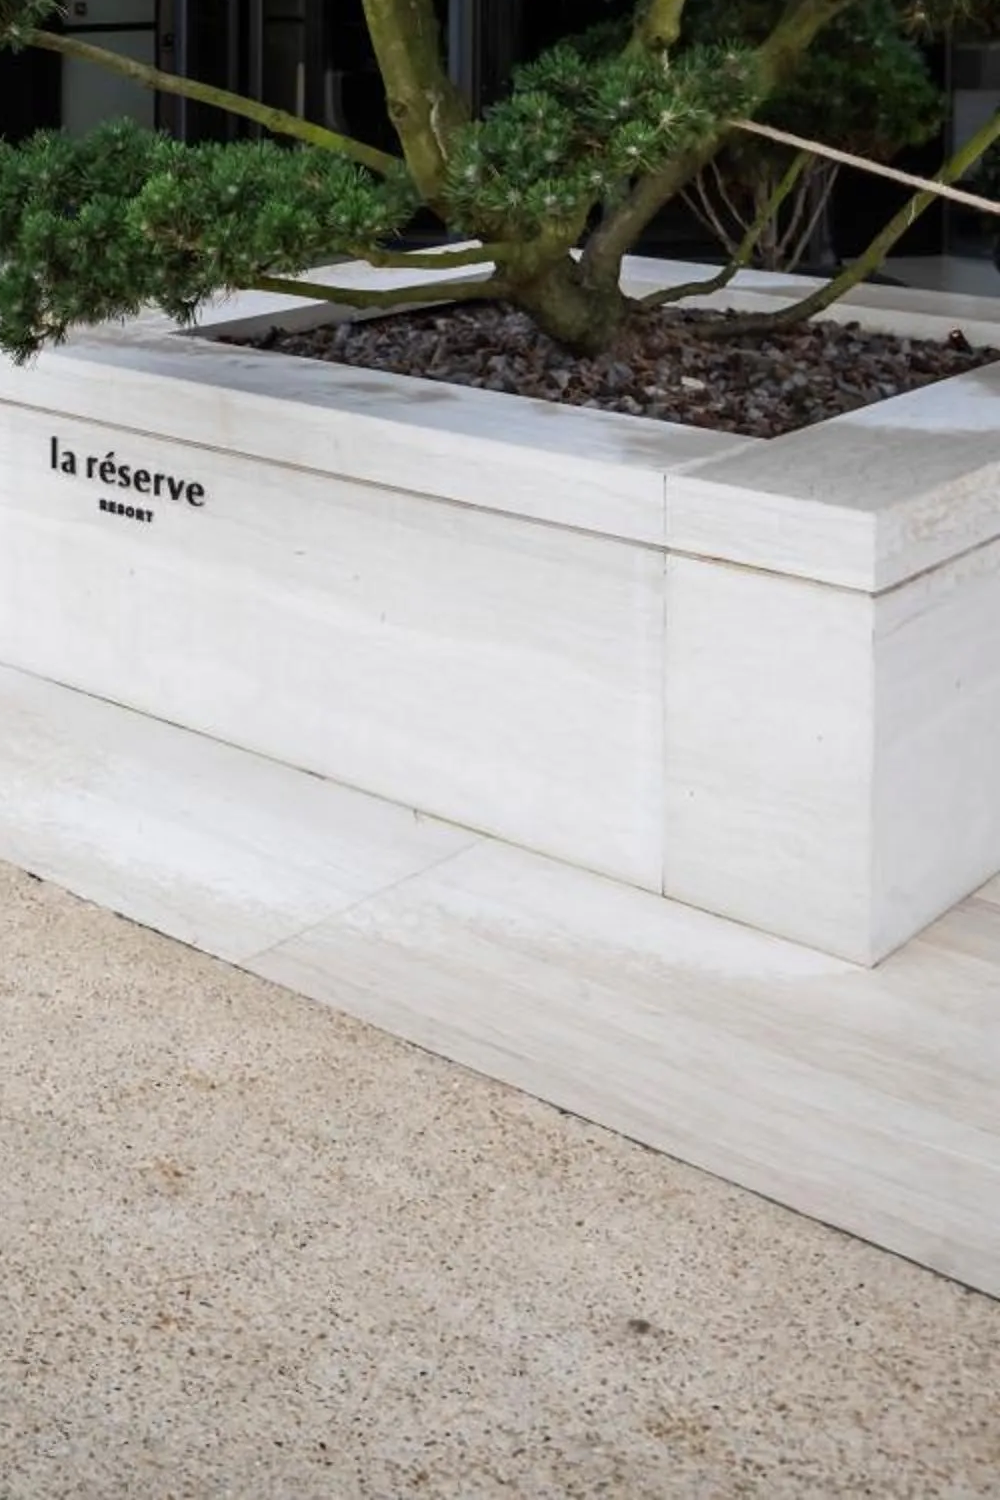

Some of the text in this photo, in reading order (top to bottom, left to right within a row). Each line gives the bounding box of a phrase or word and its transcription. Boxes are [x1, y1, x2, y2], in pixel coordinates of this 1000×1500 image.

[51, 435, 206, 508] la réserve
[99, 499, 154, 523] RESORT
